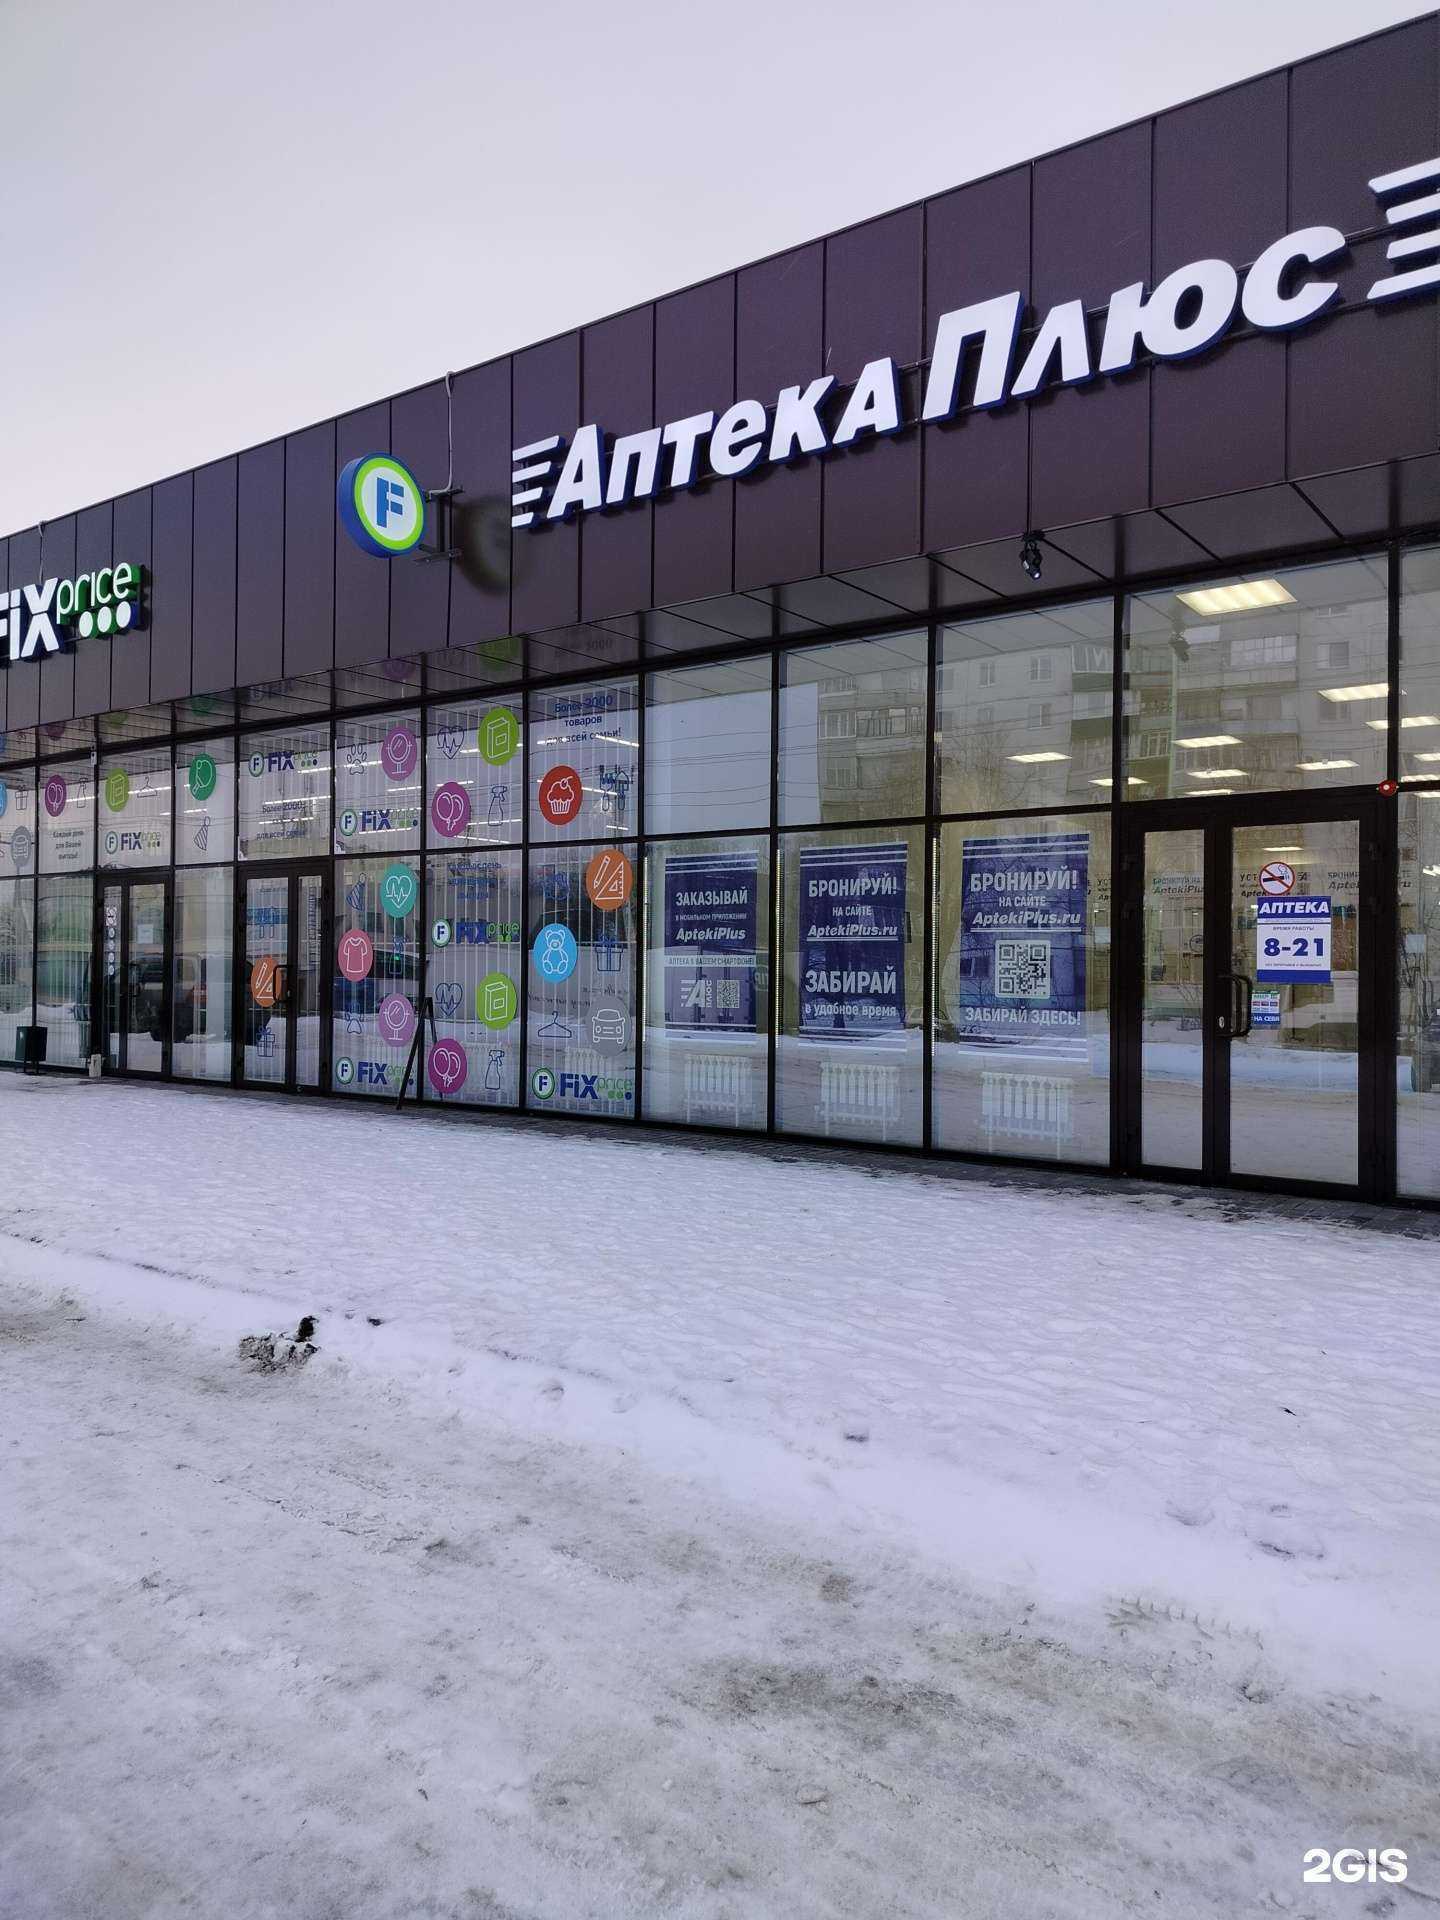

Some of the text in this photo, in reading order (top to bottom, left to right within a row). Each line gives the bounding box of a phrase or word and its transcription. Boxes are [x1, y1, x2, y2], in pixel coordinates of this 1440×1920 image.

[377, 477, 404, 528] F
[57, 562, 133, 624] price
[565, 716, 602, 727] товаров
[808, 872, 897, 898] БРОНИРУЙ!
[970, 866, 1077, 892] БРОНИРУЙ!
[676, 886, 748, 906] ЗАКАЗЫВАЙ
[999, 893, 1046, 907] НА САЙТЕ
[832, 904, 872, 917] НА САЙТЕ
[1259, 901, 1329, 914] АПТЕКА
[973, 911, 1081, 926] AptekiPlus.ru
[488, 922, 520, 938] price
[675, 927, 747, 942] AptekiPlus
[808, 924, 898, 939] AptekiPlus.ru
[1264, 937, 1324, 957] 8-21
[805, 965, 896, 994] ЗАБИРАЙ
[805, 1003, 897, 1018] в удобное время
[965, 1006, 1080, 1026] ЗАБИРАЙ ЗДЕСЬ!
[597, 1078, 632, 1092] price
